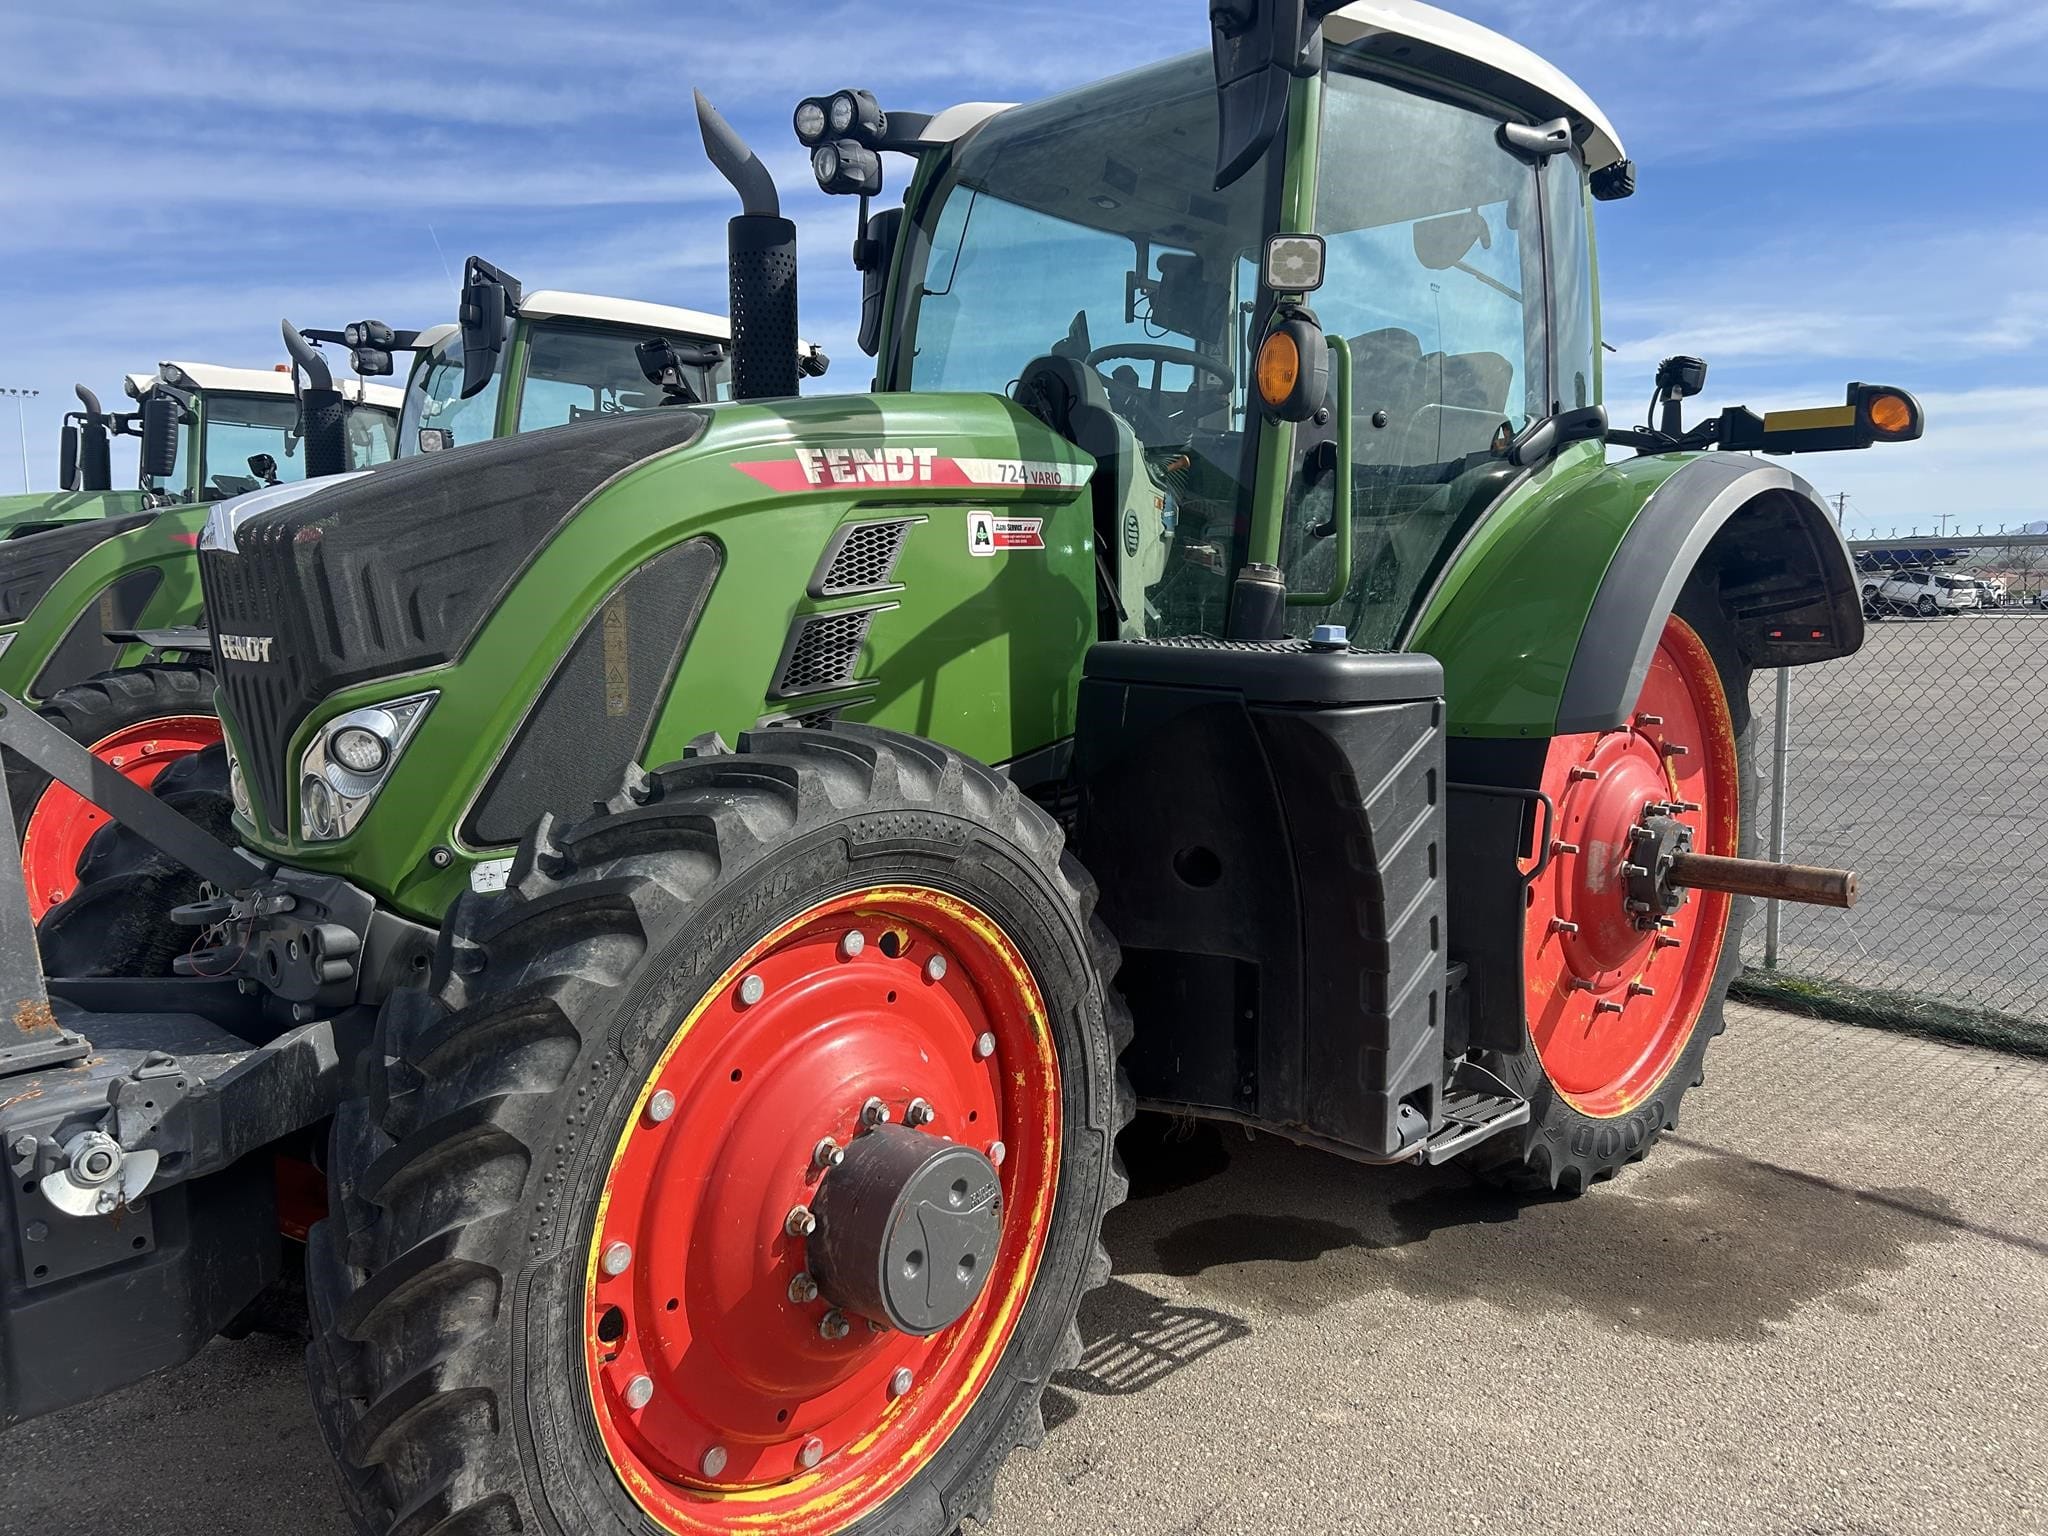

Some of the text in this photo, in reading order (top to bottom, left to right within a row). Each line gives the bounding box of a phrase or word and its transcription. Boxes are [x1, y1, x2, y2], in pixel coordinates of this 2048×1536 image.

[795, 447, 938, 484] FENDT
[998, 464, 1062, 485] 724 VARIO
[219, 634, 273, 662] FENDT
